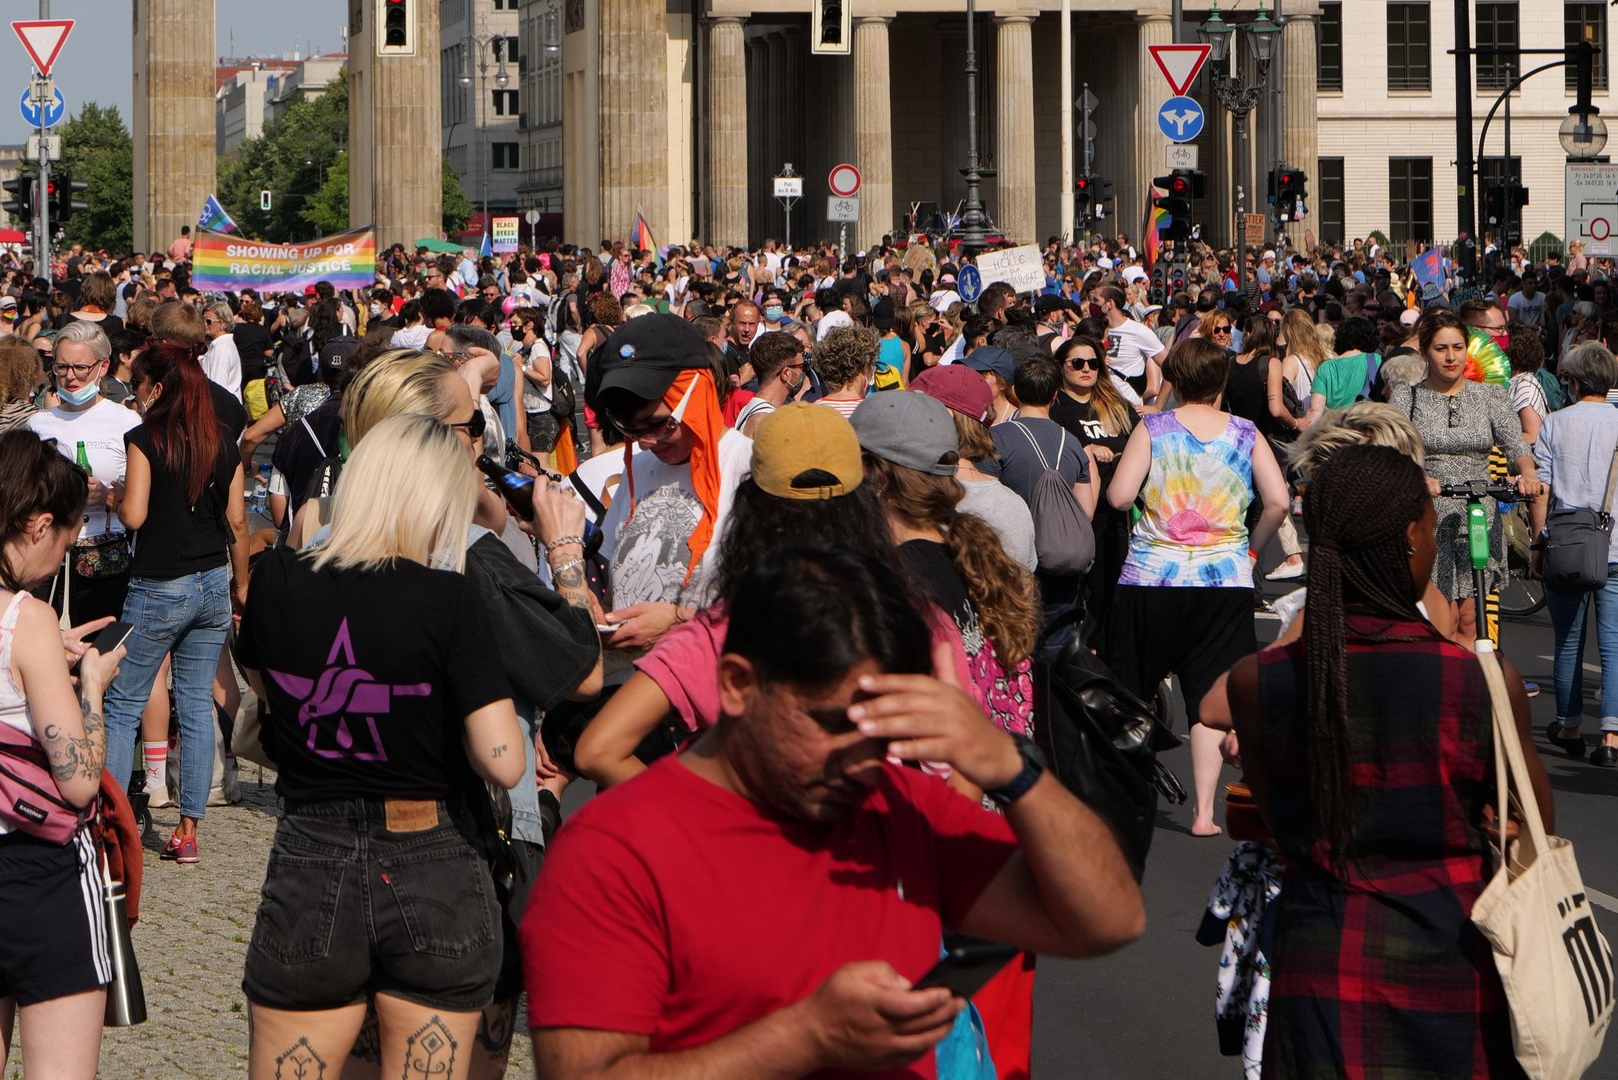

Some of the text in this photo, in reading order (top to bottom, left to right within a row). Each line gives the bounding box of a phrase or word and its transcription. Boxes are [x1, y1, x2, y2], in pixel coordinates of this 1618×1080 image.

[226, 243, 355, 259] SHOWING UP FOR
[229, 259, 352, 275] RACIAL JUSTICE
[19, 804, 44, 820] EASTPAK
